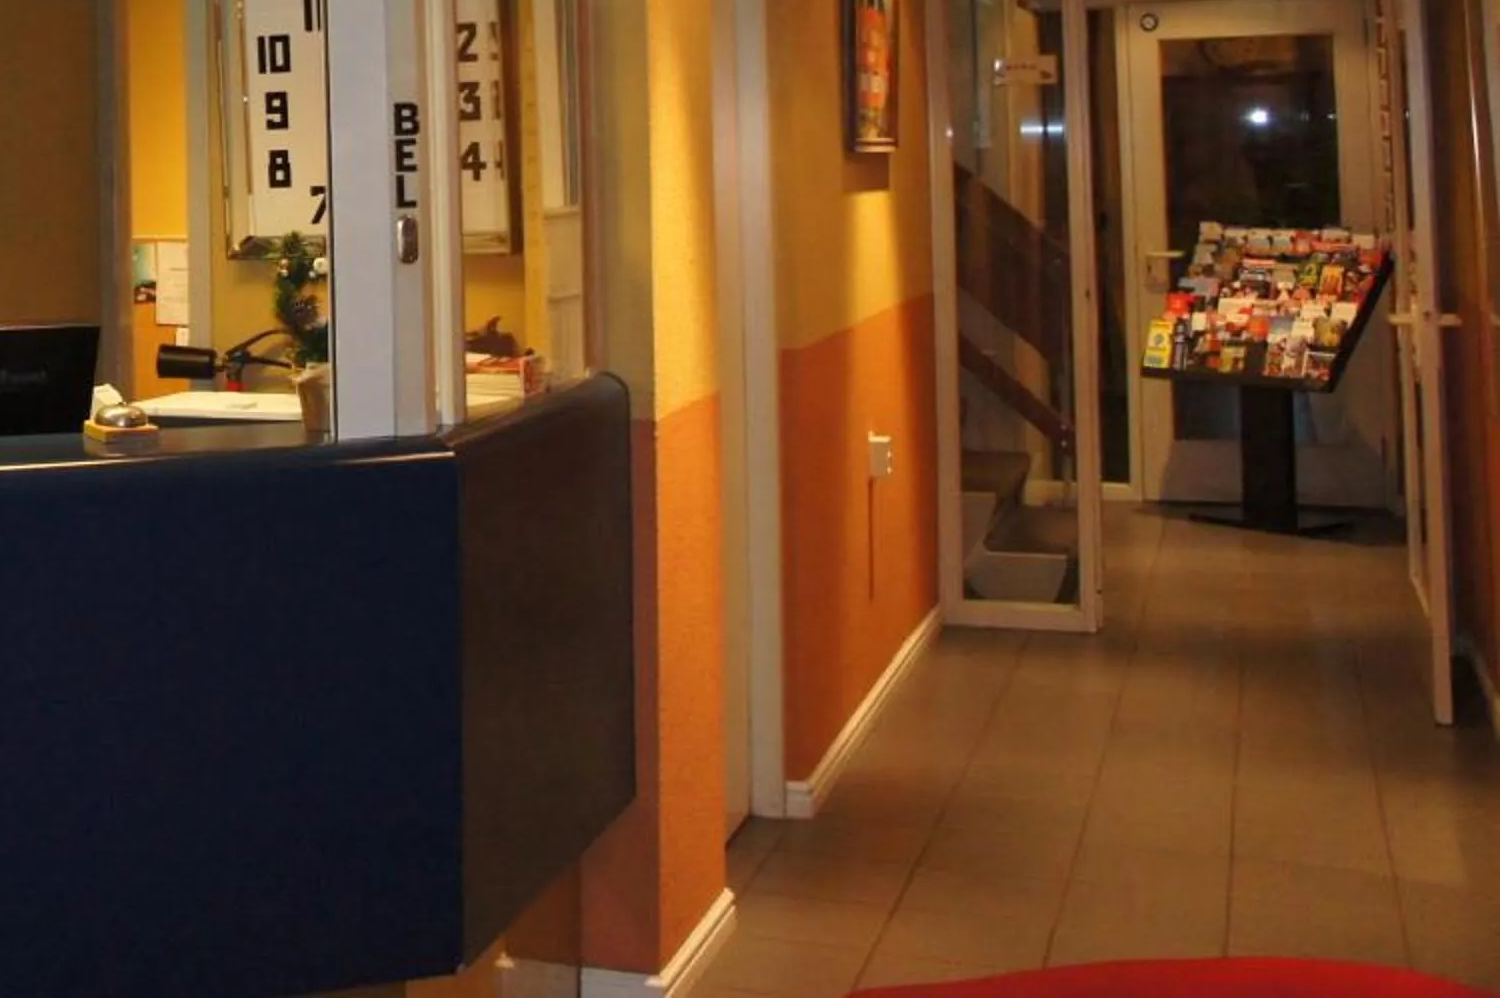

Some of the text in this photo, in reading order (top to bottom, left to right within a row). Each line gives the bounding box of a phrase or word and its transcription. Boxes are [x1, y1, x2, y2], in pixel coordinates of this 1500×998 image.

[257, 34, 291, 74] 10
[455, 22, 479, 62] 2
[265, 91, 289, 130] 9
[458, 82, 481, 121] 3
[268, 149, 292, 188] 8
[394, 103, 419, 208] BEL
[460, 141, 487, 182] 4
[309, 185, 327, 224] 7
